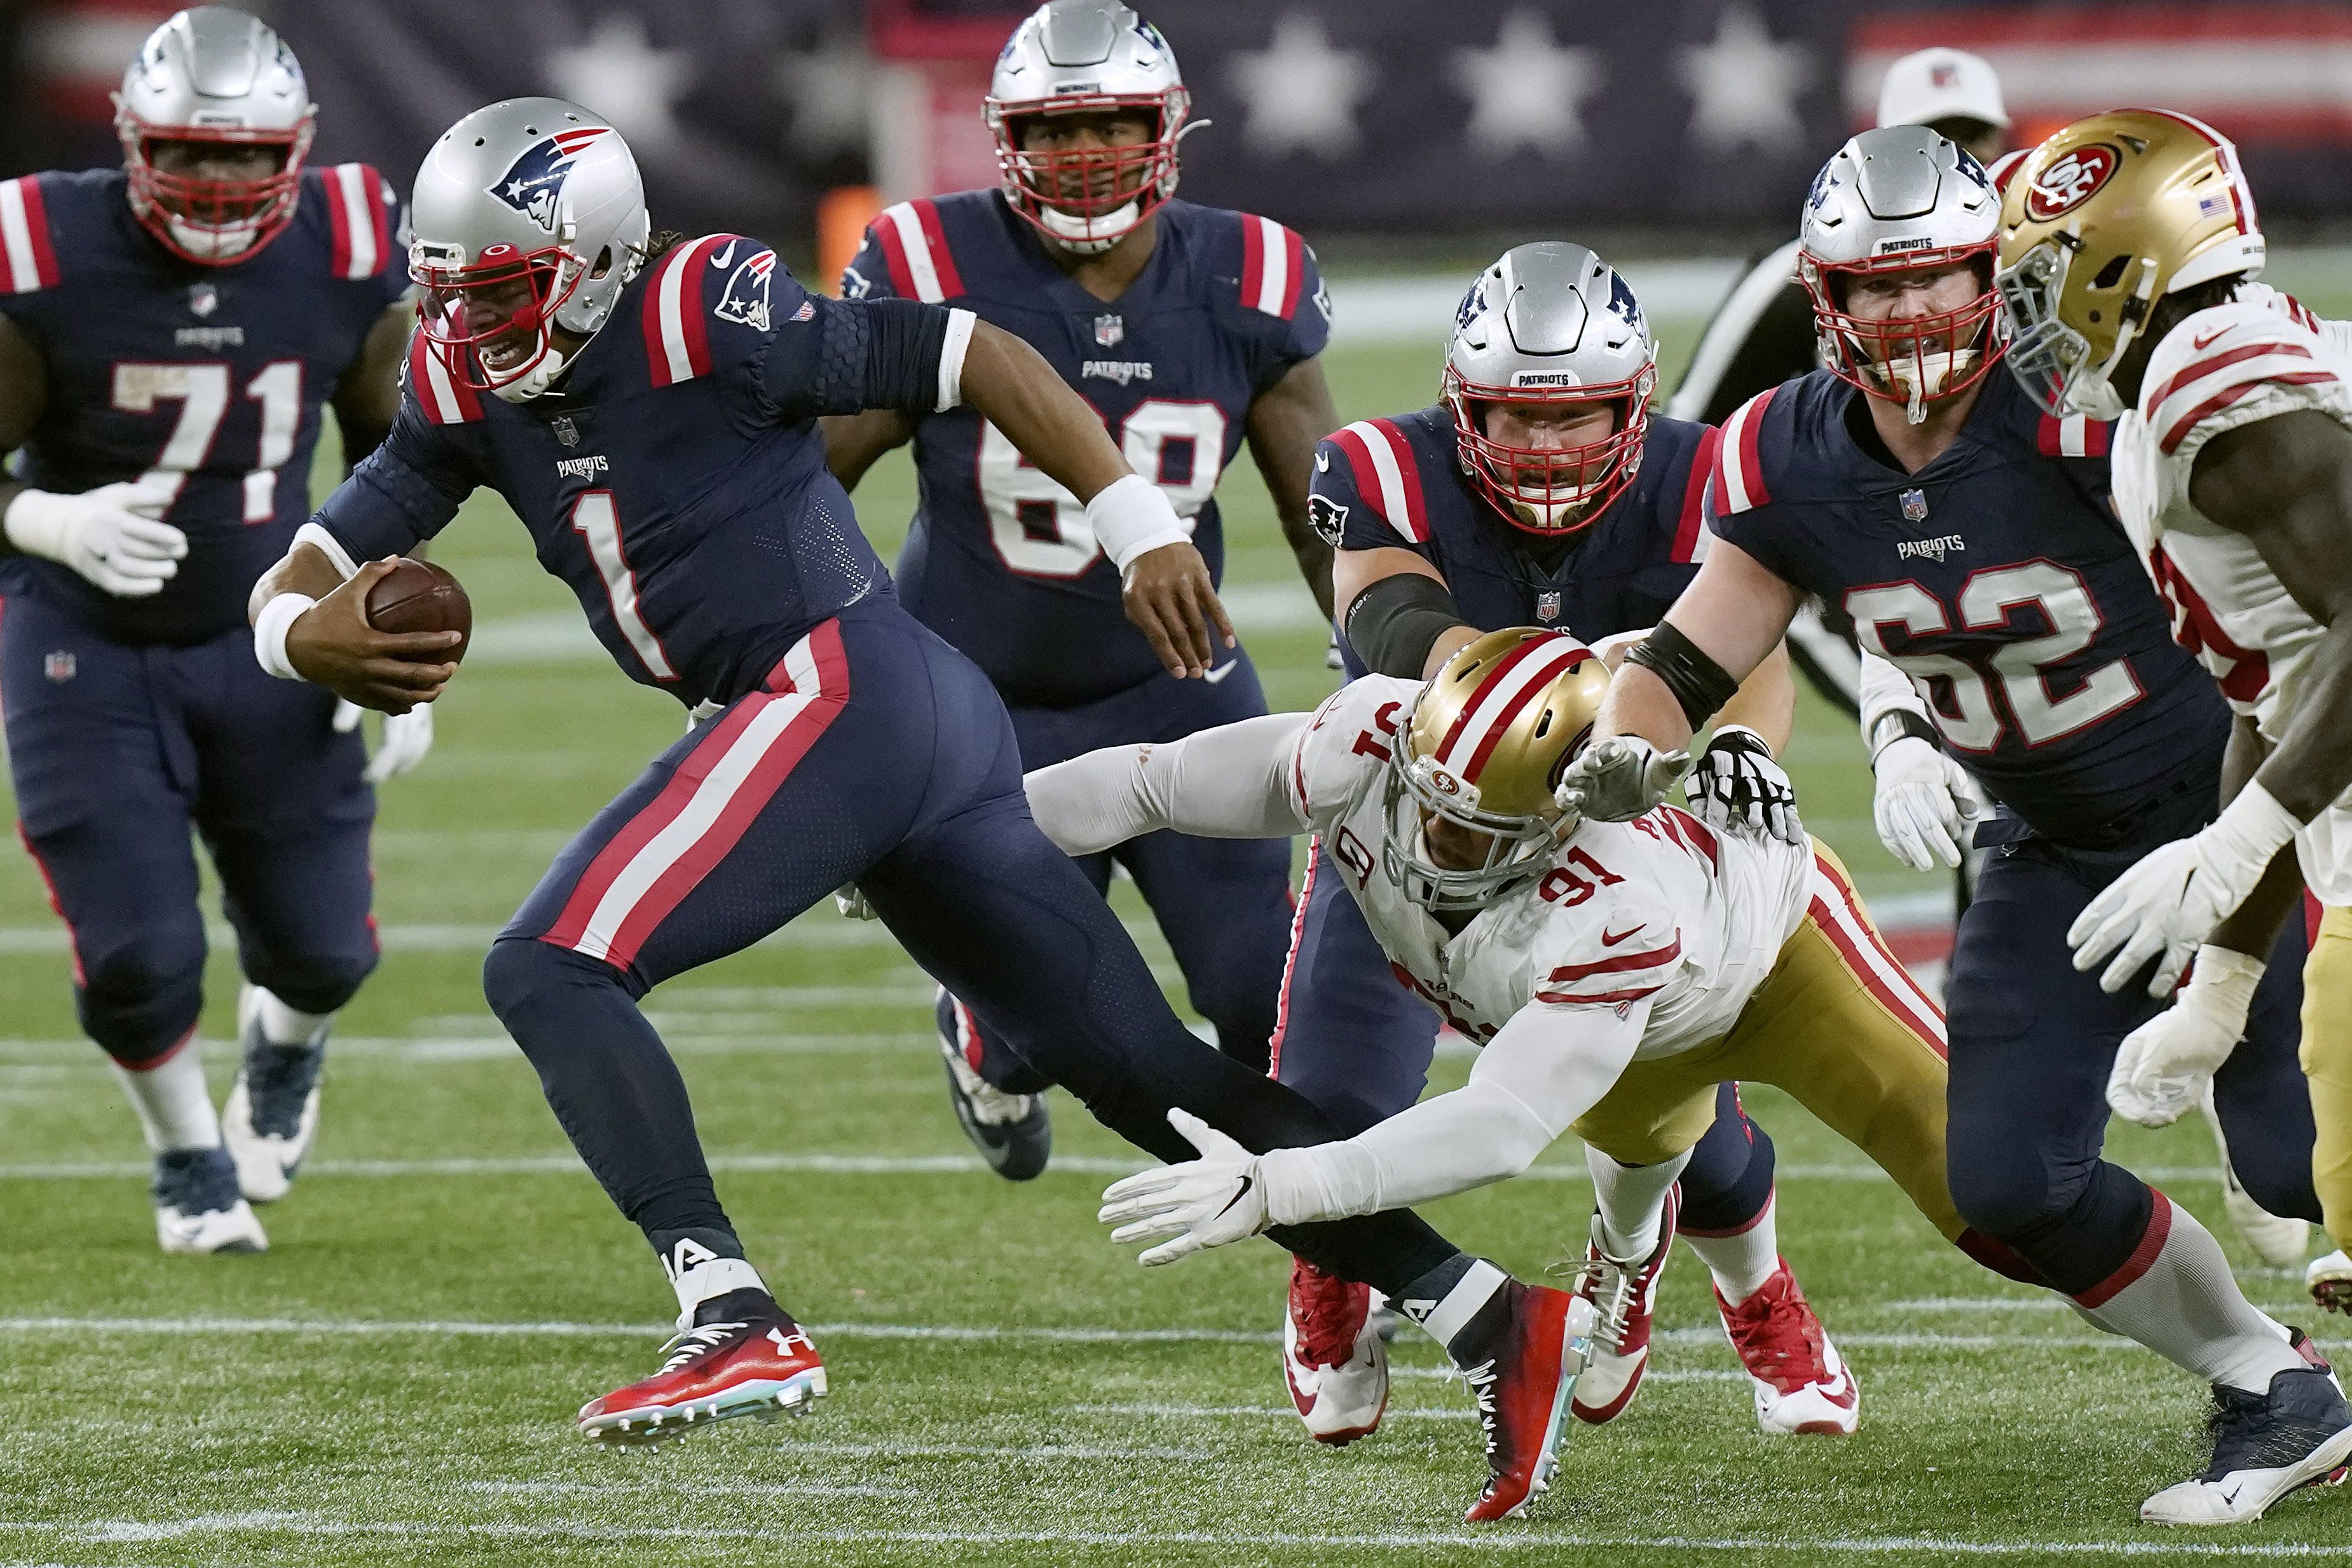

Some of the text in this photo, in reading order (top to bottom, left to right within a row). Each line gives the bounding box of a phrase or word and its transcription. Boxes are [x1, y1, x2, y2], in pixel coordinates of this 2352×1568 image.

[1882, 237, 1932, 254] PATRIOTS
[1082, 360, 1152, 381] PATRIOTS
[1519, 374, 1569, 387] PATRIOTS
[111, 358, 306, 524] 71
[557, 455, 608, 479] PATRIOTS
[1897, 535, 1965, 561] PATRIOTS
[570, 489, 681, 681] 1
[1843, 556, 2147, 755] 62
[1539, 845, 1627, 908] 91
